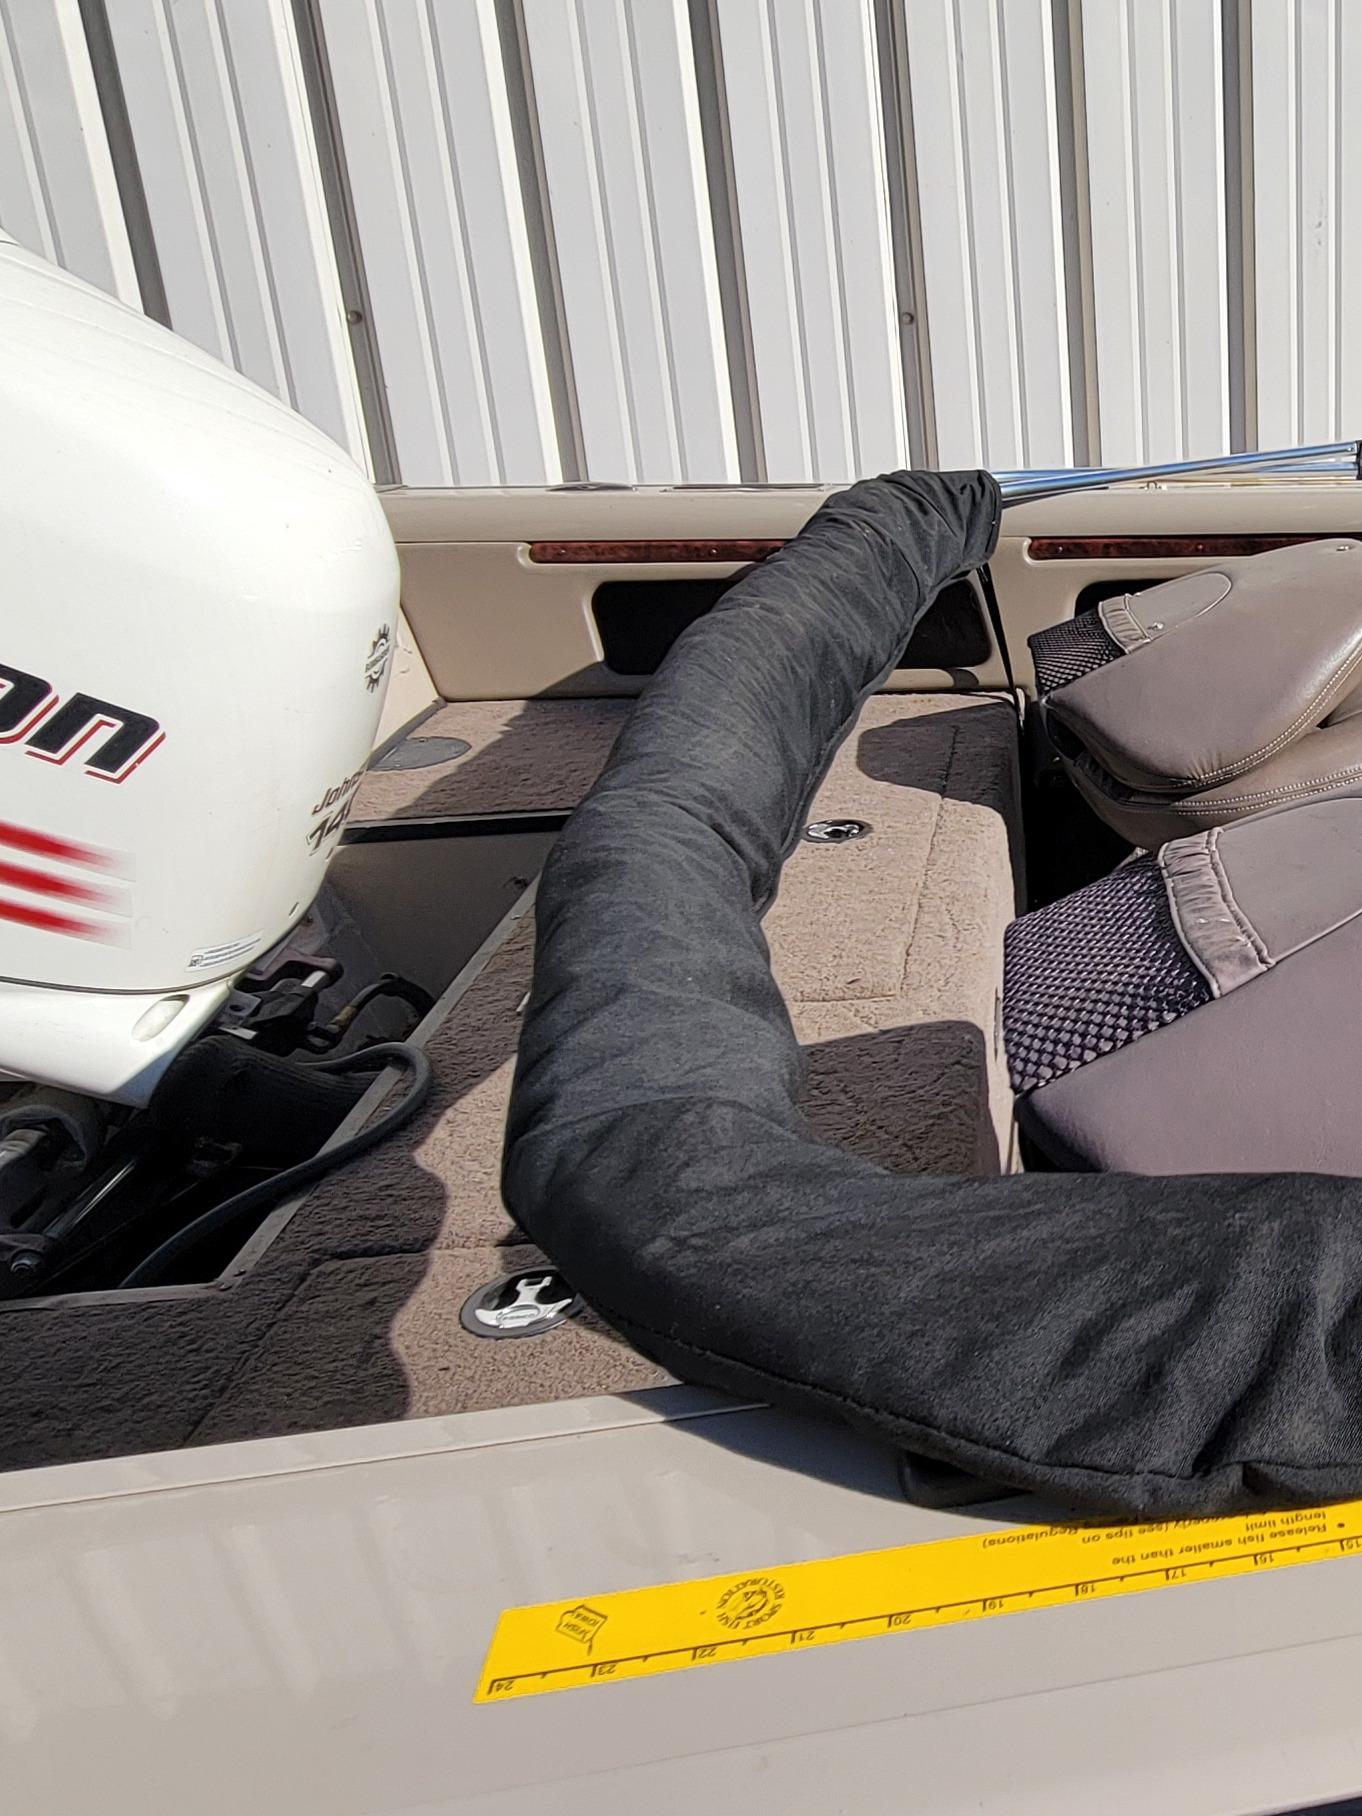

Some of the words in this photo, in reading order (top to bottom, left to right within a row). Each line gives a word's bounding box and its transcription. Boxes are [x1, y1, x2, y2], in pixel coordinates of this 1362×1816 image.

[1279, 1511, 1327, 1526] length
[1245, 1519, 1277, 1532] limit
[1269, 1522, 1327, 1539] Release
[1081, 1534, 1102, 1544] on
[1105, 1527, 1134, 1540] tips
[1237, 1533, 1265, 1545] fish
[1178, 1538, 1233, 1555] smaller
[1345, 1538, 1362, 1550] 15
[1111, 1554, 1136, 1565] the
[1140, 1548, 1174, 1561] than
[1171, 1567, 1187, 1580] 17
[1080, 1582, 1096, 1595] 18
[988, 1597, 1004, 1610] 19
[716, 1612, 740, 1629] FISH
[742, 1603, 782, 1630] SPORT
[894, 1613, 912, 1626] 20
[798, 1630, 816, 1642] 21
[698, 1646, 717, 1659] 22
[597, 1663, 617, 1676] 23
[496, 1679, 516, 1692] 24
